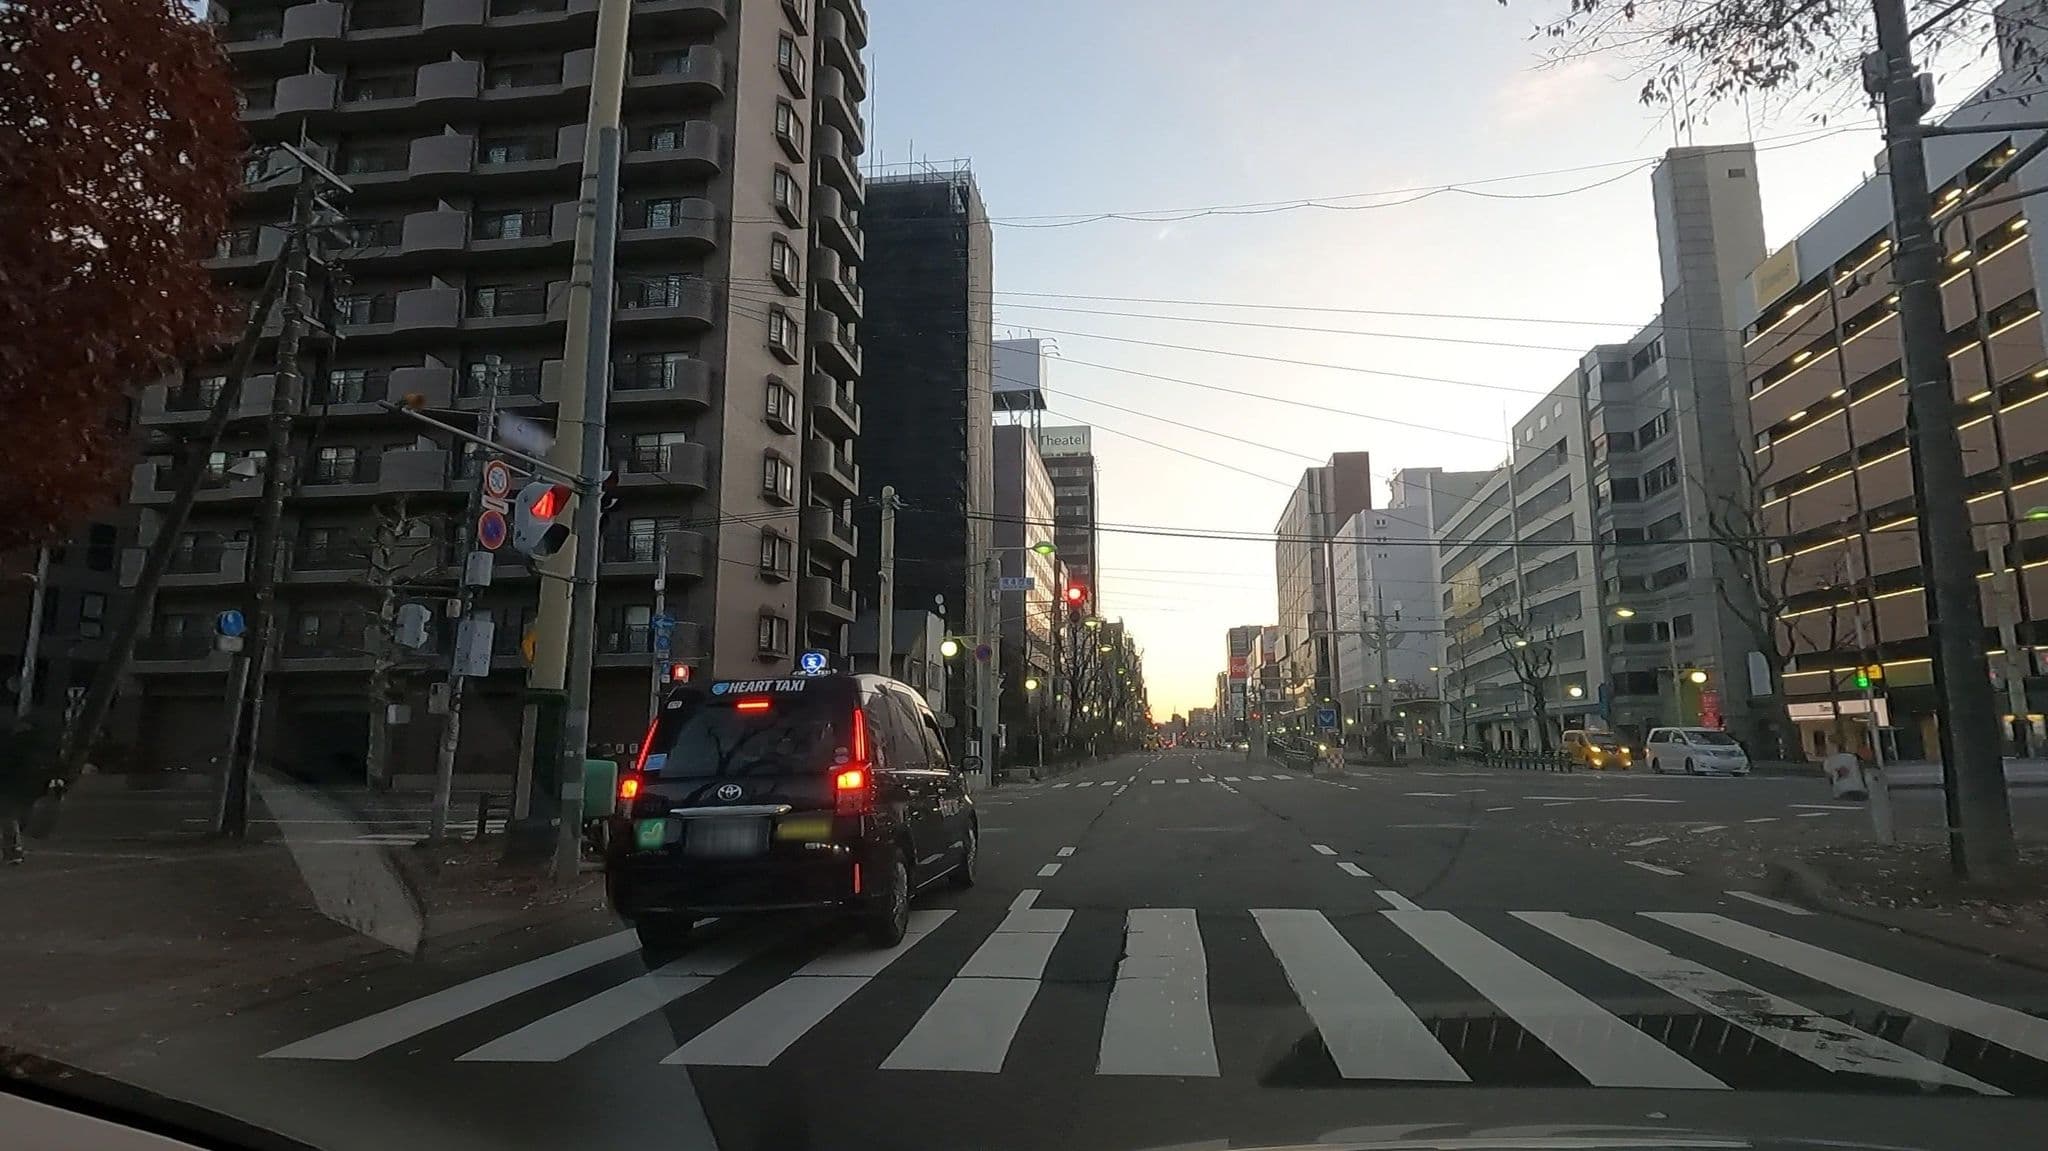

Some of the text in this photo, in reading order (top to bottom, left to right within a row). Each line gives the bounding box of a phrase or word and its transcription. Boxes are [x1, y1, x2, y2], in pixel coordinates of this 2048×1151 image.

[1040, 433, 1085, 446] Theatel
[728, 680, 805, 693] HEART TAXI
